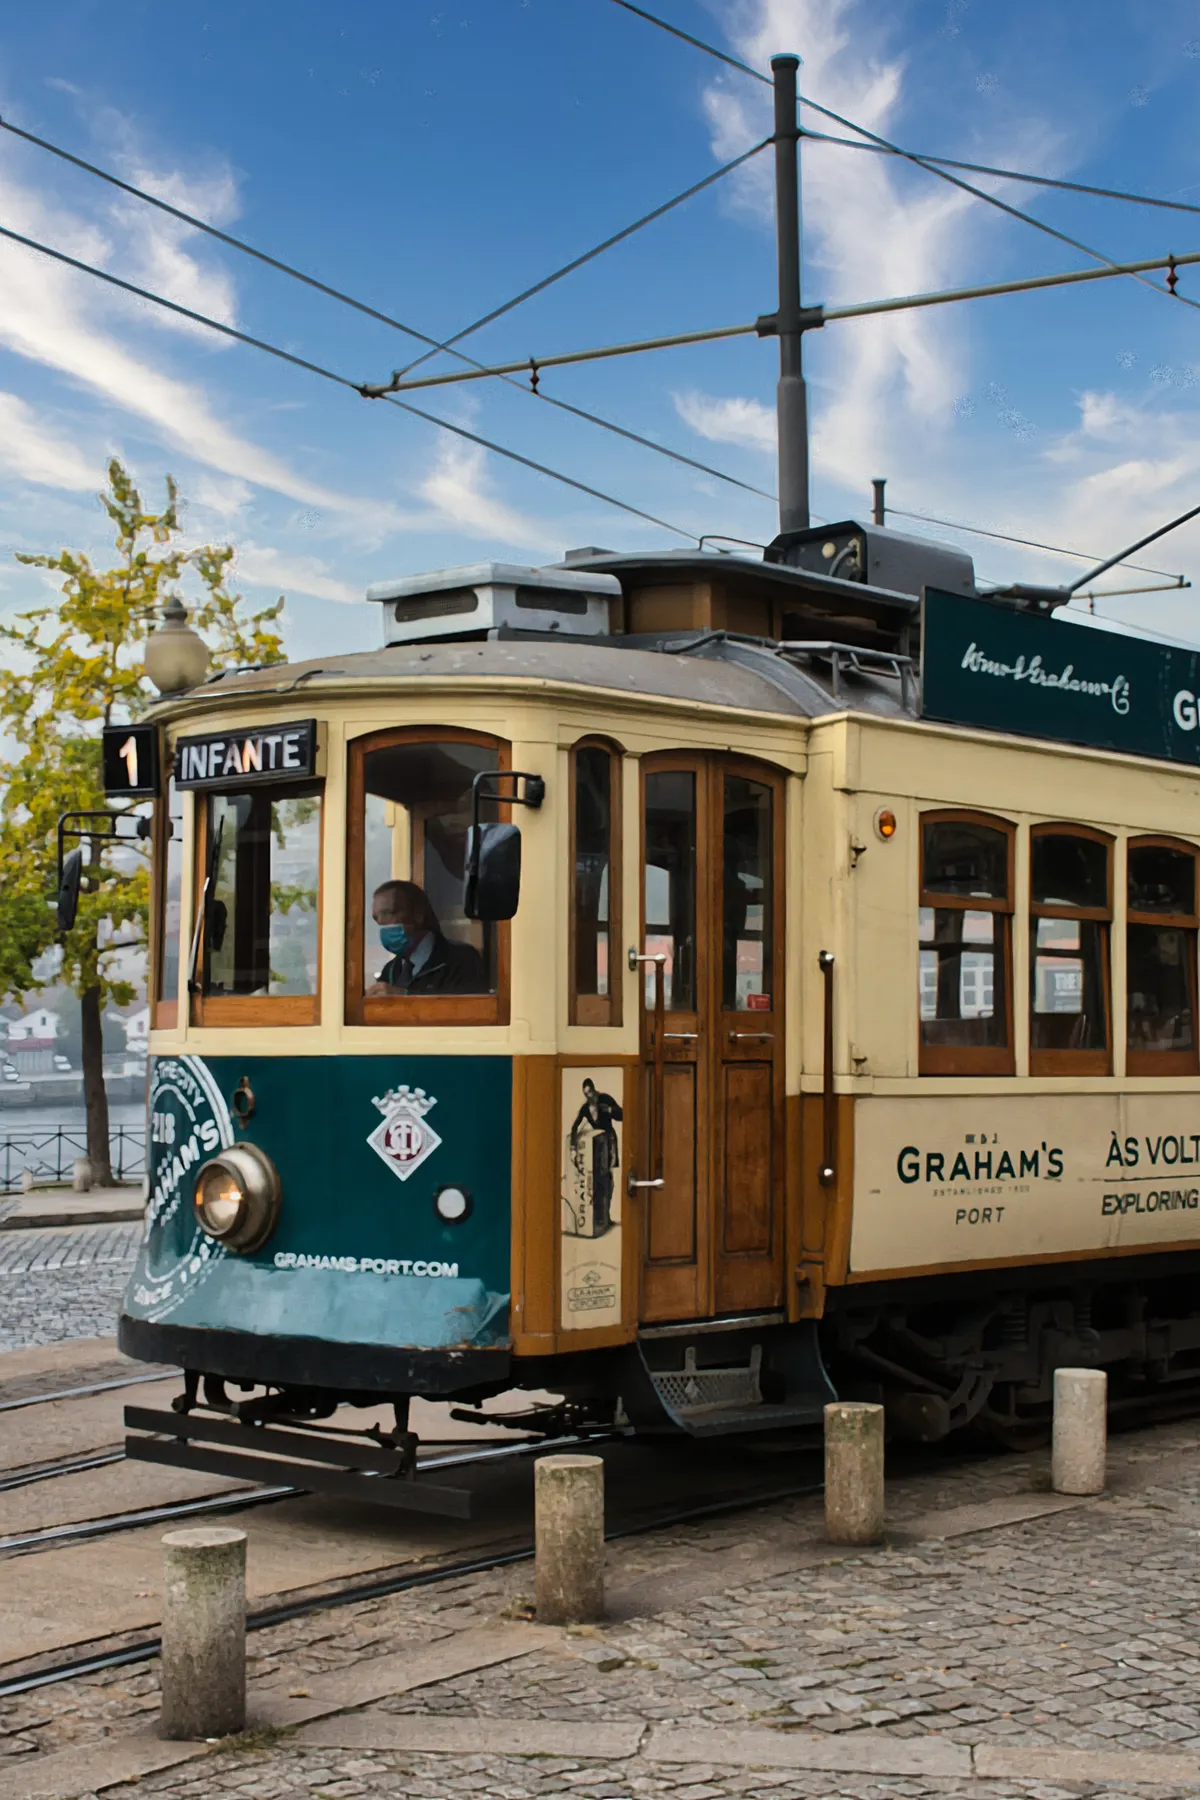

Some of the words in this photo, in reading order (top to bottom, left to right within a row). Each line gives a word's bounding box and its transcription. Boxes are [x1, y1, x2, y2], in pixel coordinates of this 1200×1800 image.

[1173, 689, 1200, 733] G
[118, 735, 138, 787] 1
[181, 733, 301, 780] INFANTE
[152, 1111, 175, 1144] 218
[897, 1141, 1065, 1184] GRAHAM'S
[1105, 1130, 1139, 1167] ÀS
[1145, 1135, 1200, 1165] VOLT
[955, 1206, 1005, 1225] PORT
[1101, 1188, 1199, 1216] EXPLORING
